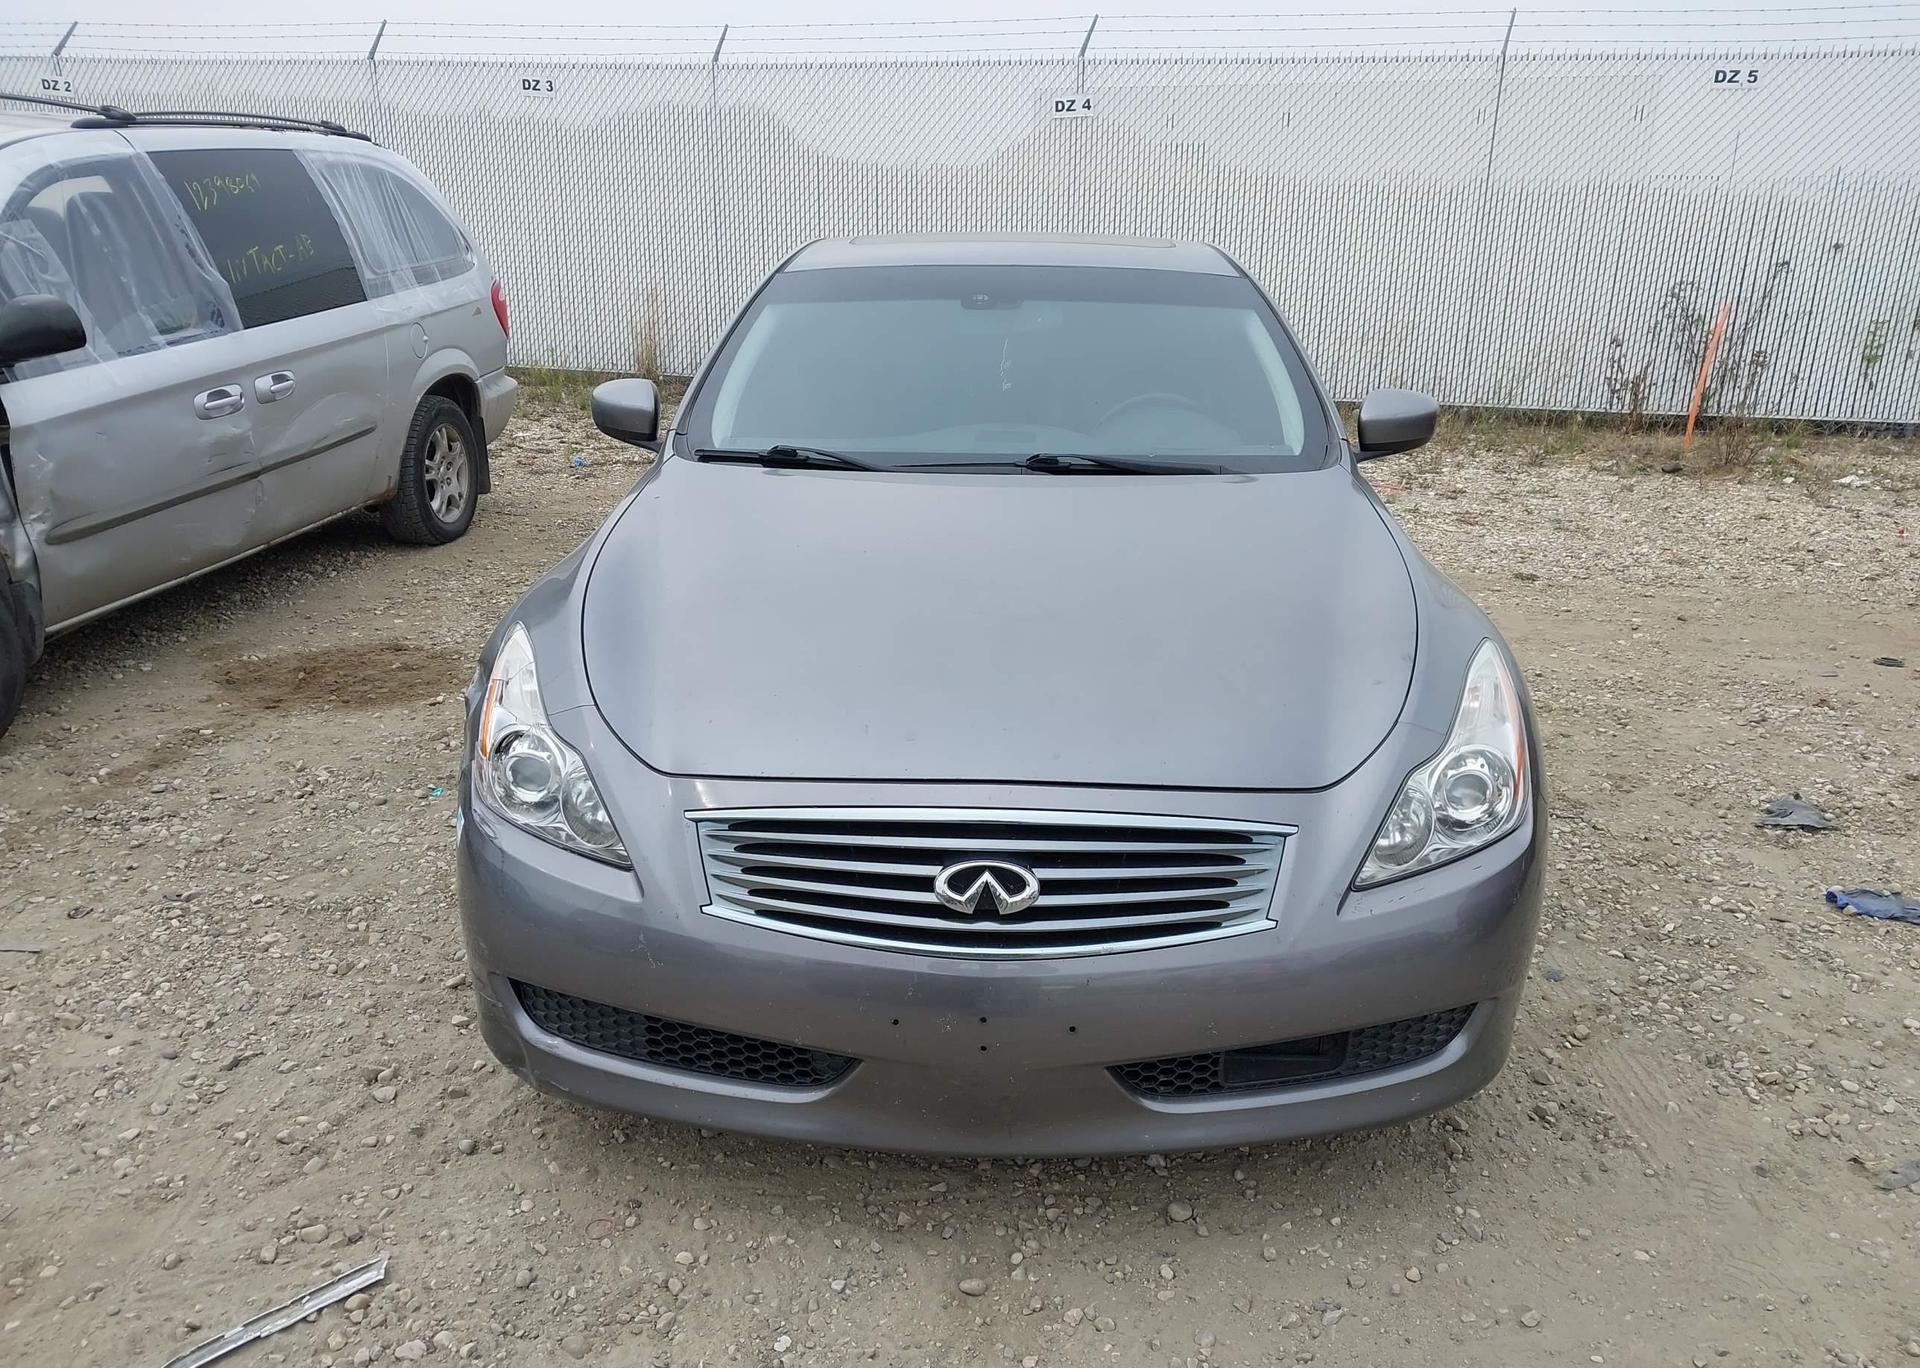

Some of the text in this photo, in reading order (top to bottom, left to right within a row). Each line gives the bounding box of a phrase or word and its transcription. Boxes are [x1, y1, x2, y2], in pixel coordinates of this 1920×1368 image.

[1713, 69, 1759, 84] DZ 5
[41, 78, 72, 92] DZ 2
[522, 78, 554, 92] DZ 3
[1054, 97, 1092, 113] DZ 4
